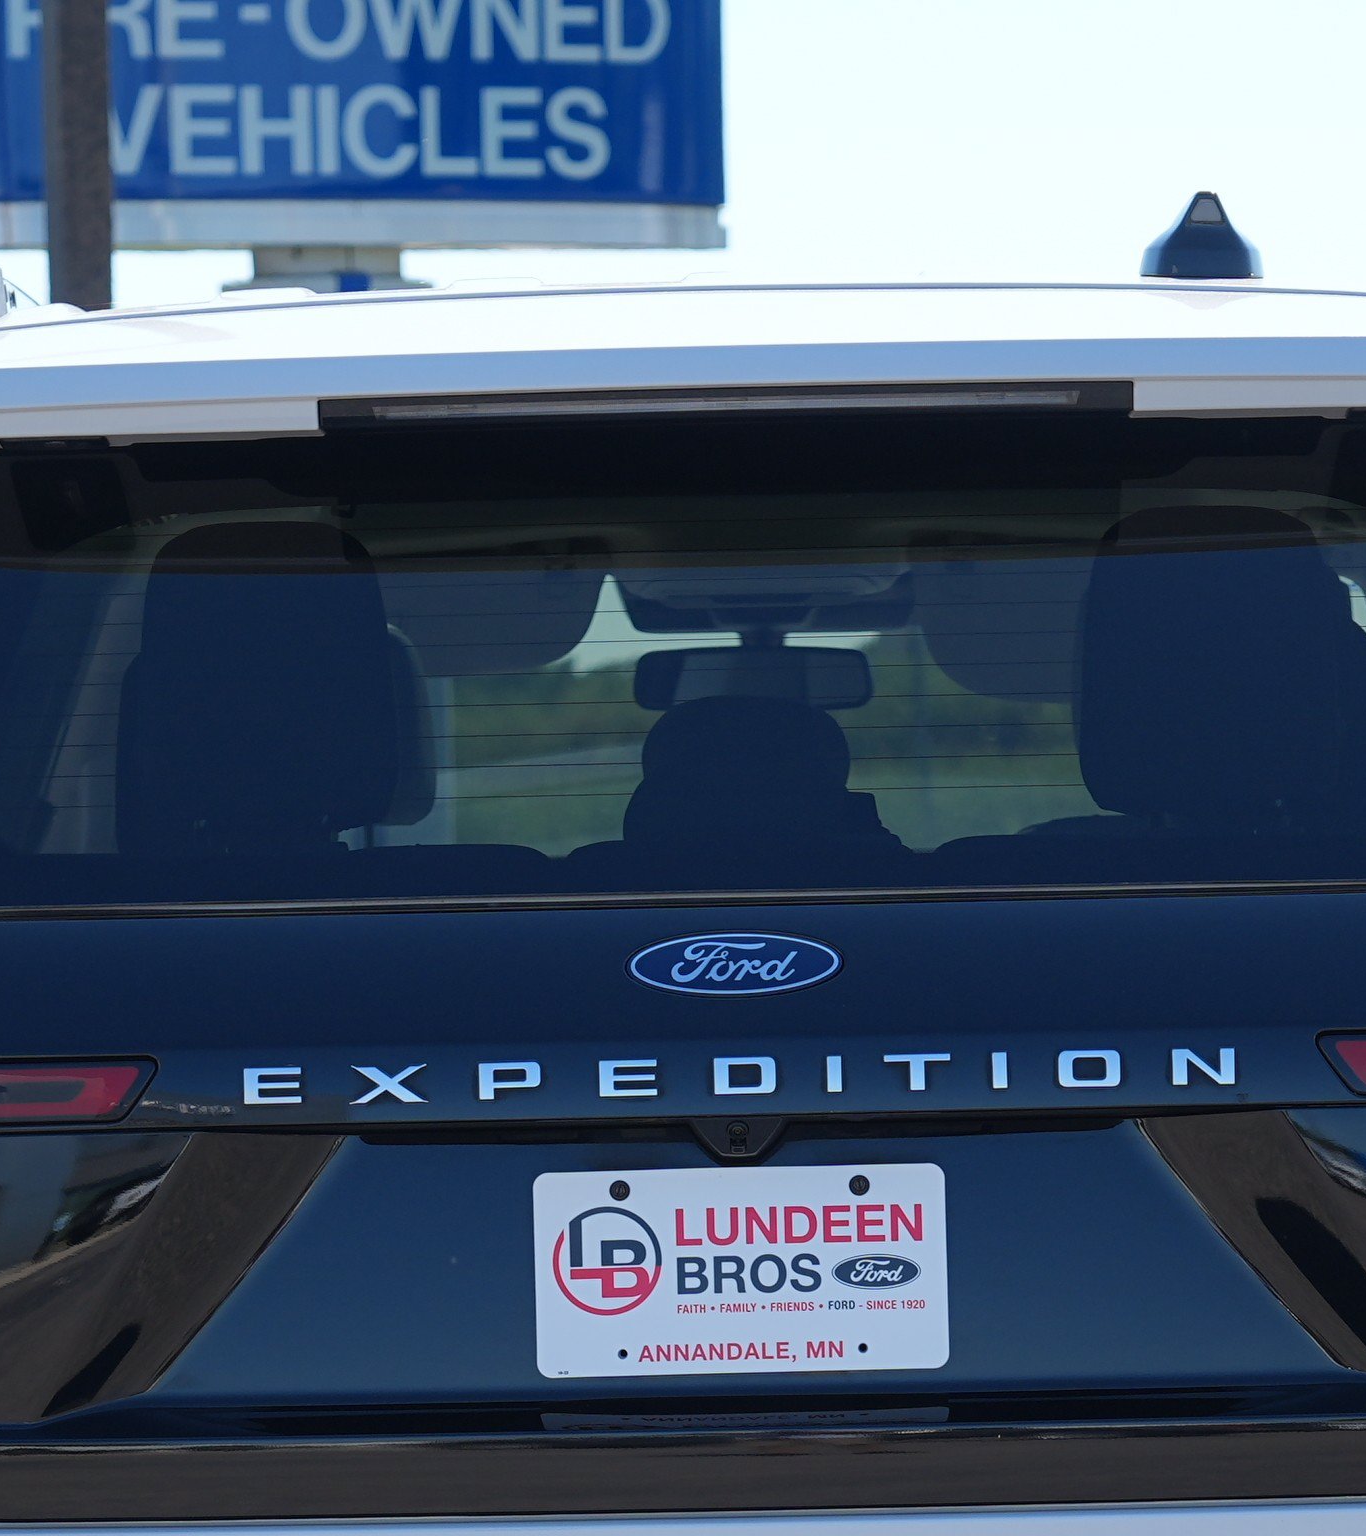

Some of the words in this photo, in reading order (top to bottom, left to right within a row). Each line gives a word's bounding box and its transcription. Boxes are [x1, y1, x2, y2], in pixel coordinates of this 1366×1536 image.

[111, 85, 609, 177] VEHICLES
[671, 941, 798, 983] Ford
[243, 1047, 1237, 1105] EXPEDITION
[675, 1203, 923, 1247] LUNDEEN
[676, 1252, 822, 1295] BROS
[850, 1259, 904, 1282] Ford
[677, 1303, 706, 1314] FAITH
[719, 1302, 757, 1313] FAMILY
[770, 1301, 815, 1312] FRIENDS
[828, 1299, 856, 1311] FORD
[866, 1299, 897, 1311] SINCE
[901, 1299, 926, 1310] 1920
[638, 1341, 797, 1363] ANNANDALE,
[806, 1340, 844, 1359] MN
